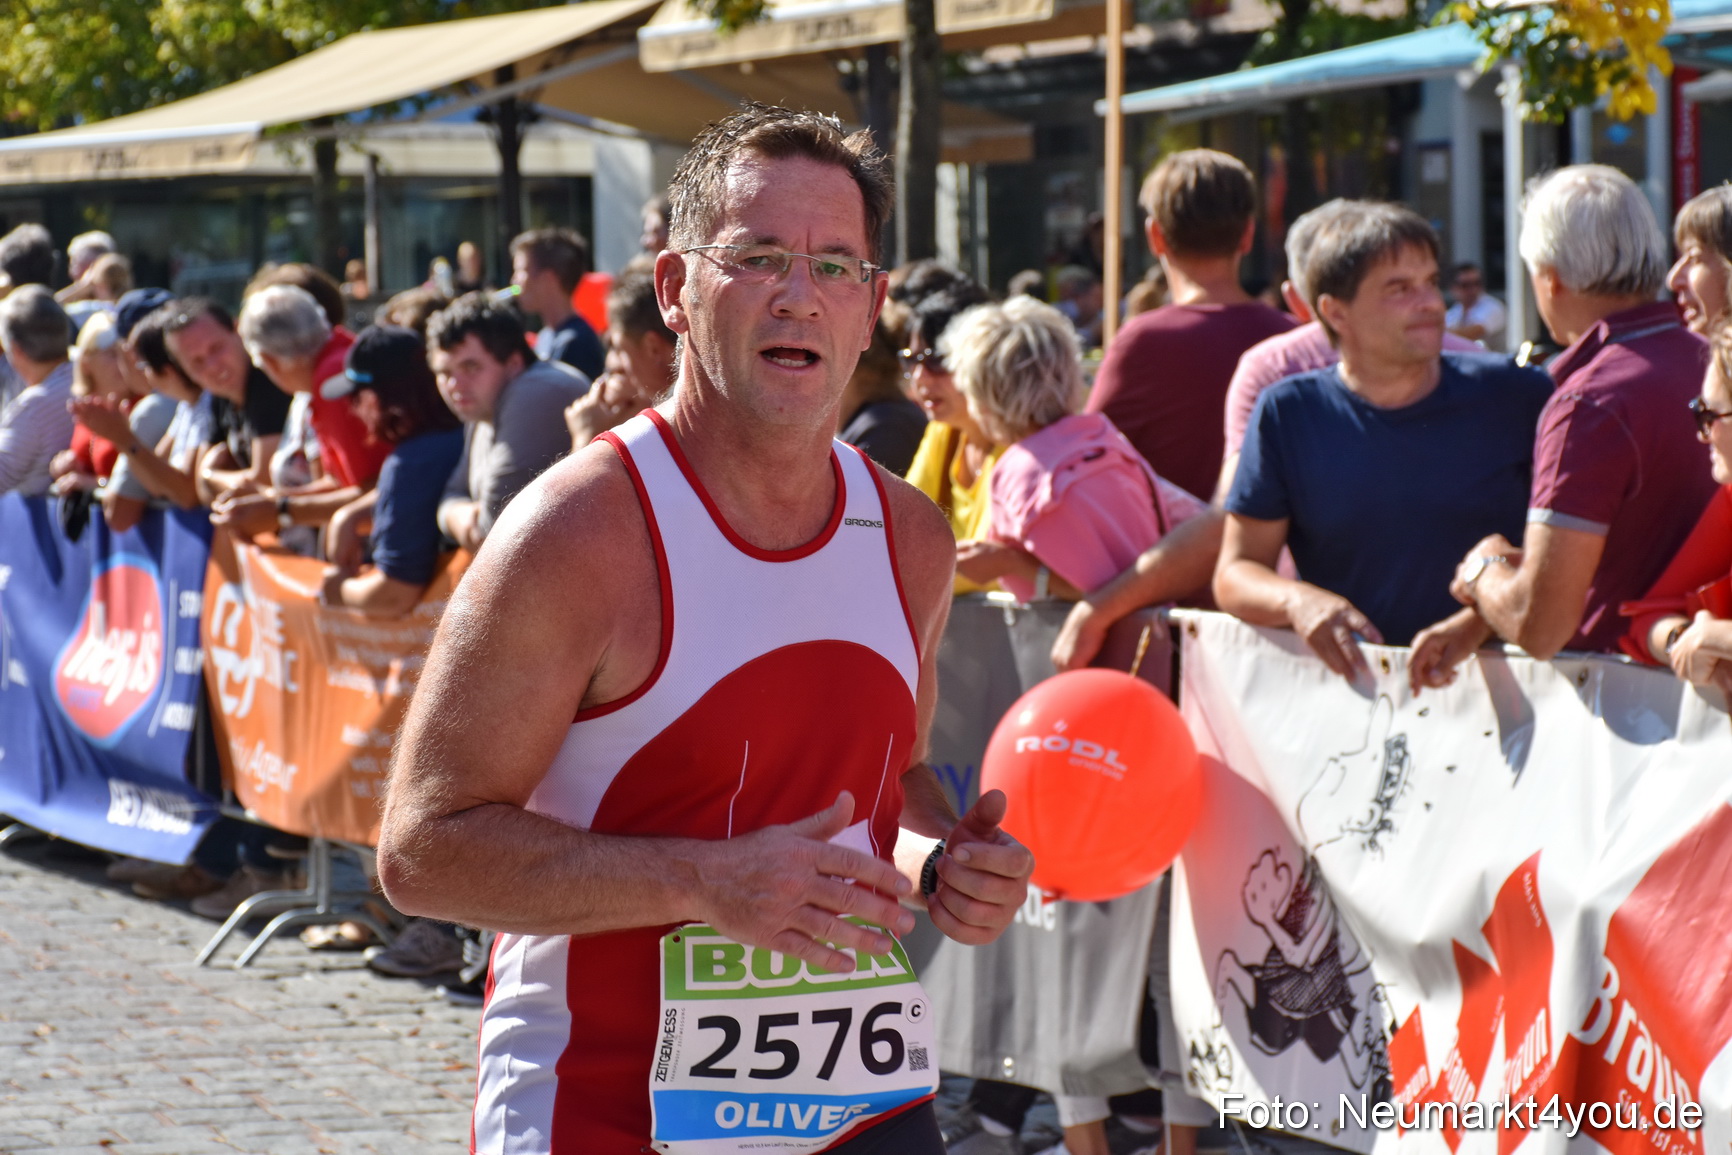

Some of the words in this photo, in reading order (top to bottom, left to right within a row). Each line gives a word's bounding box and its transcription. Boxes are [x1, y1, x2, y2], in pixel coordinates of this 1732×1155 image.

[844, 518, 883, 528] BROOKS
[1015, 719, 1128, 772] RÖDL
[911, 1004, 921, 1018] C
[689, 1001, 906, 1081] 2576
[1570, 955, 1697, 1146] Braun
